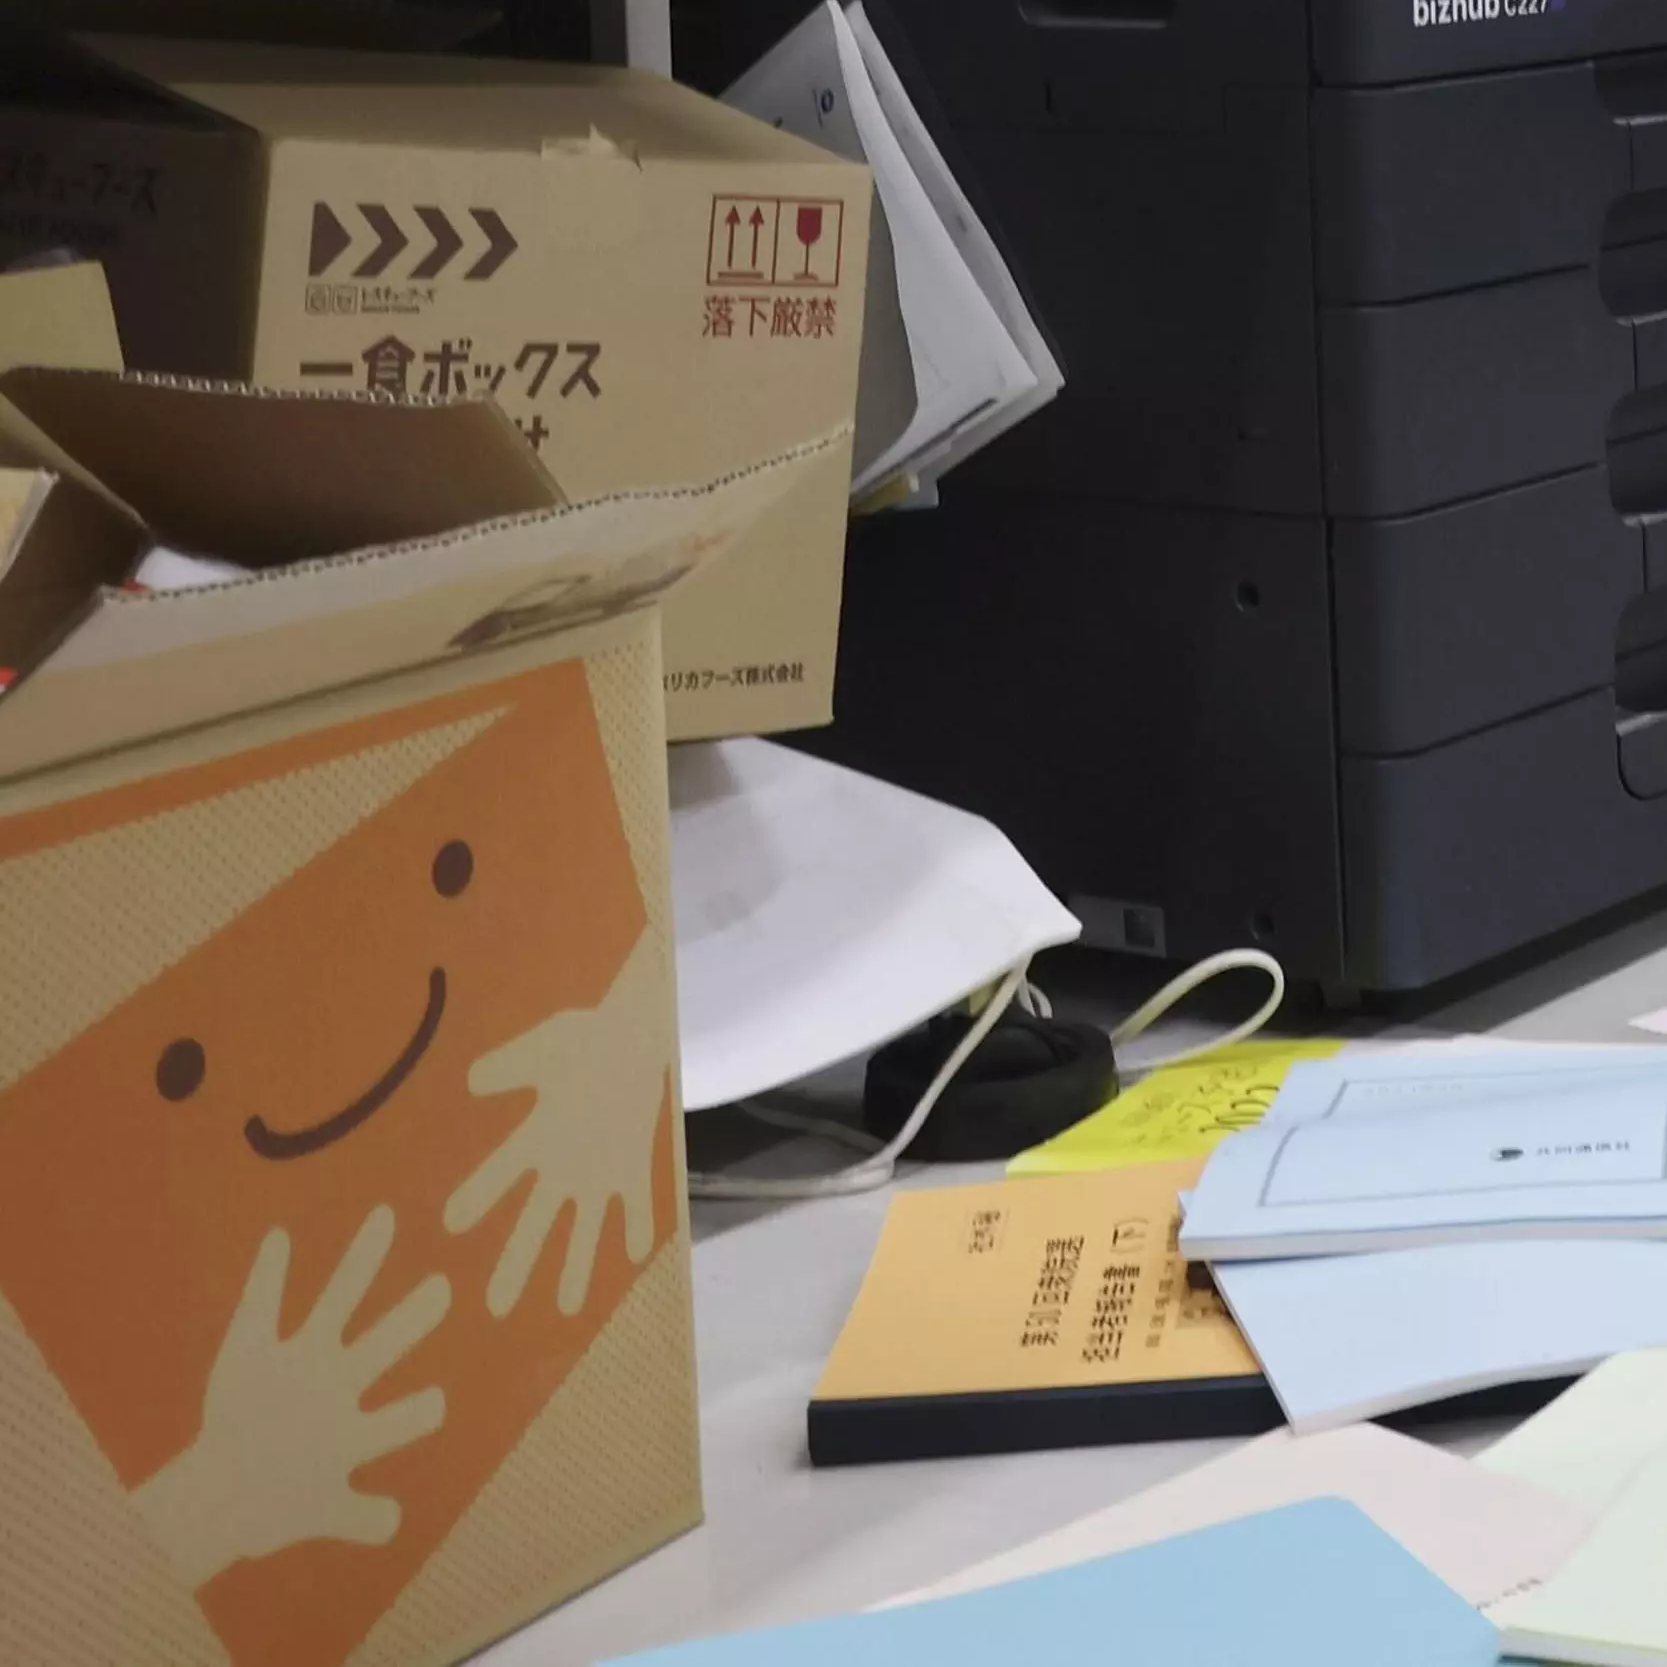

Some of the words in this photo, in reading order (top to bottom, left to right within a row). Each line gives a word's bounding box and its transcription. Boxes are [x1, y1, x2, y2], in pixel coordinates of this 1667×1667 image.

[702, 294, 837, 339] 落下厳禁
[300, 333, 602, 400] 一食ボックス
